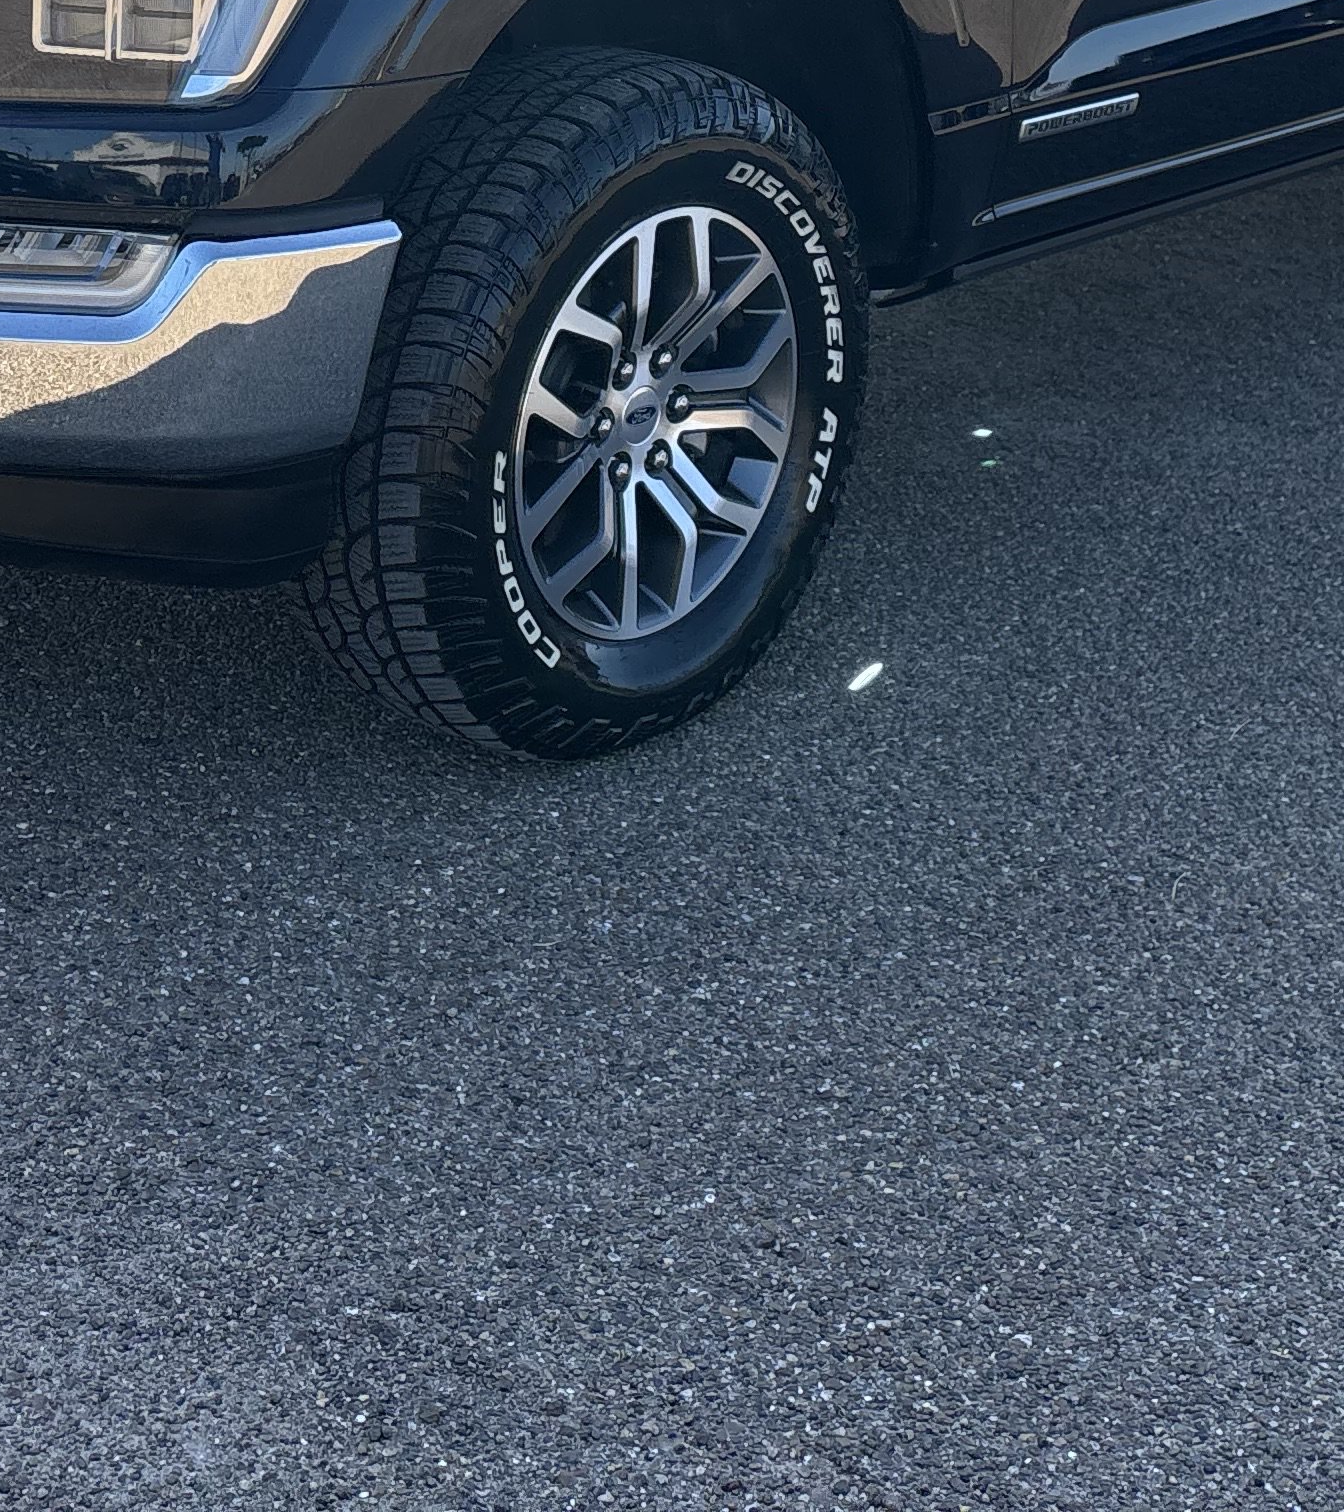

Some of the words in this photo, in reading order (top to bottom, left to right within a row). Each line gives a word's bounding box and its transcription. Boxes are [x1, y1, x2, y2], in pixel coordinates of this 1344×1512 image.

[1026, 99, 1135, 136] POWERBOOST
[725, 160, 844, 383] DISCOVERER
[806, 407, 838, 513] ATP
[492, 450, 561, 668] COOPER
